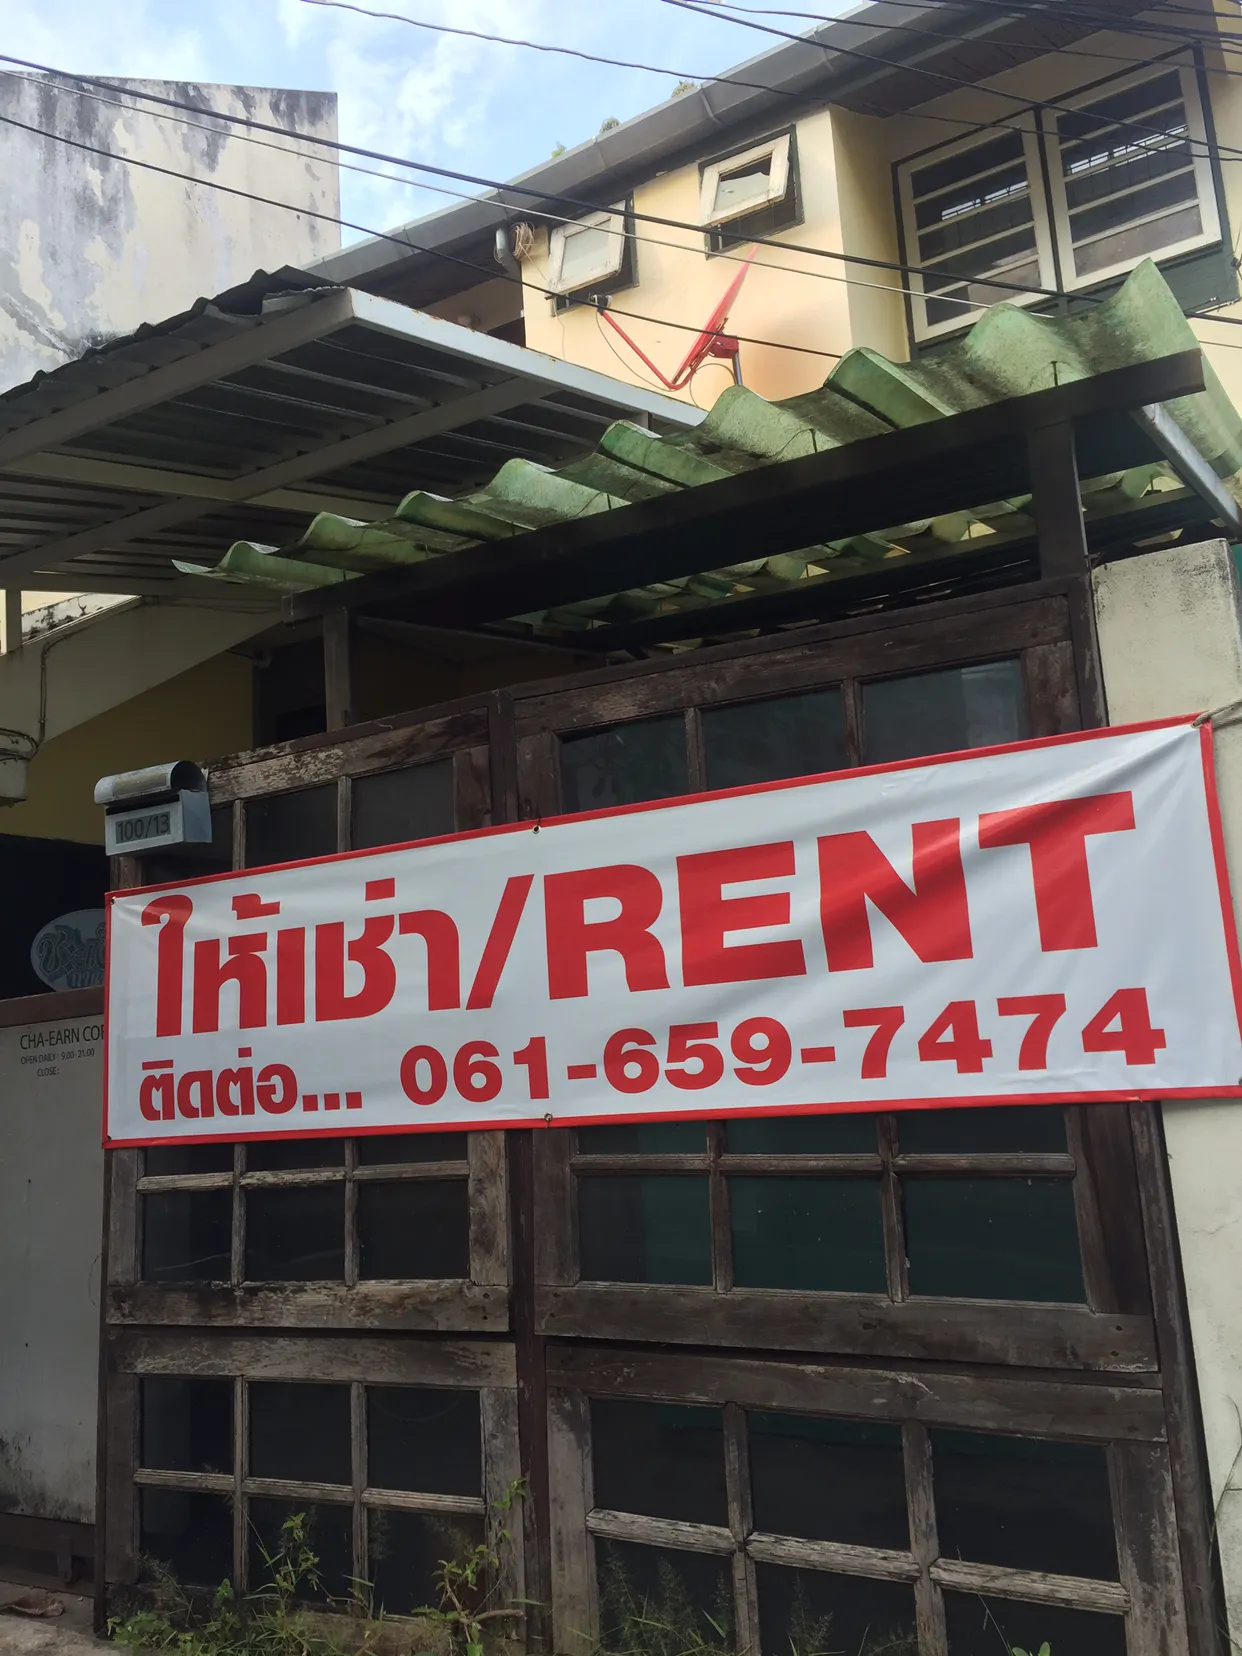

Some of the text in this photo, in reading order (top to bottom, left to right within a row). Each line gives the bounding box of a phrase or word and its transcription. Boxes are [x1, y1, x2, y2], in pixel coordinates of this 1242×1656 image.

[118, 814, 170, 841] 100/13
[20, 1027, 80, 1050] CHA-EARN
[400, 987, 1167, 1106] 061-659-7474
[20, 1055, 38, 1065] OPEN
